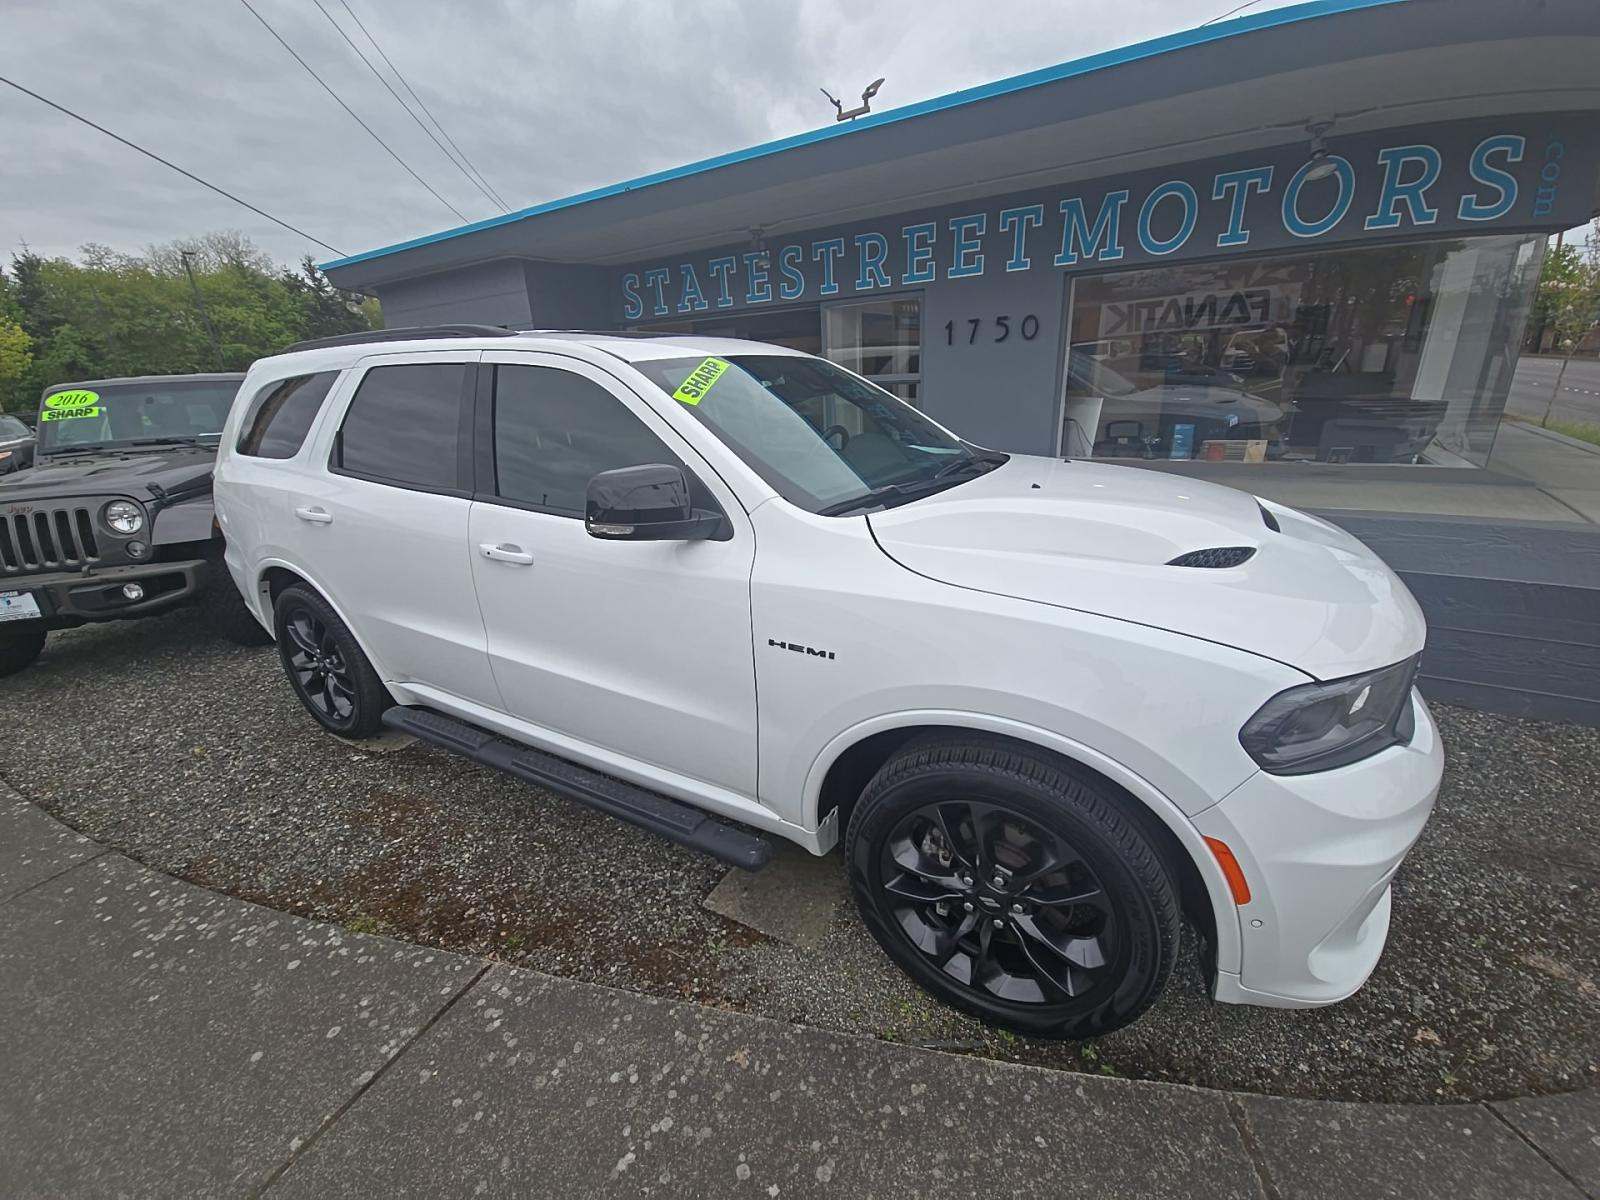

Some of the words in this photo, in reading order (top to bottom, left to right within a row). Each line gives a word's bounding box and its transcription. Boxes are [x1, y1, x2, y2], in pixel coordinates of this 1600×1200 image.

[945, 314, 1039, 346] 1750
[680, 361, 721, 398] SHARP
[54, 394, 88, 407] 2016
[48, 408, 93, 420] SHARP
[768, 639, 835, 660] HEMI
